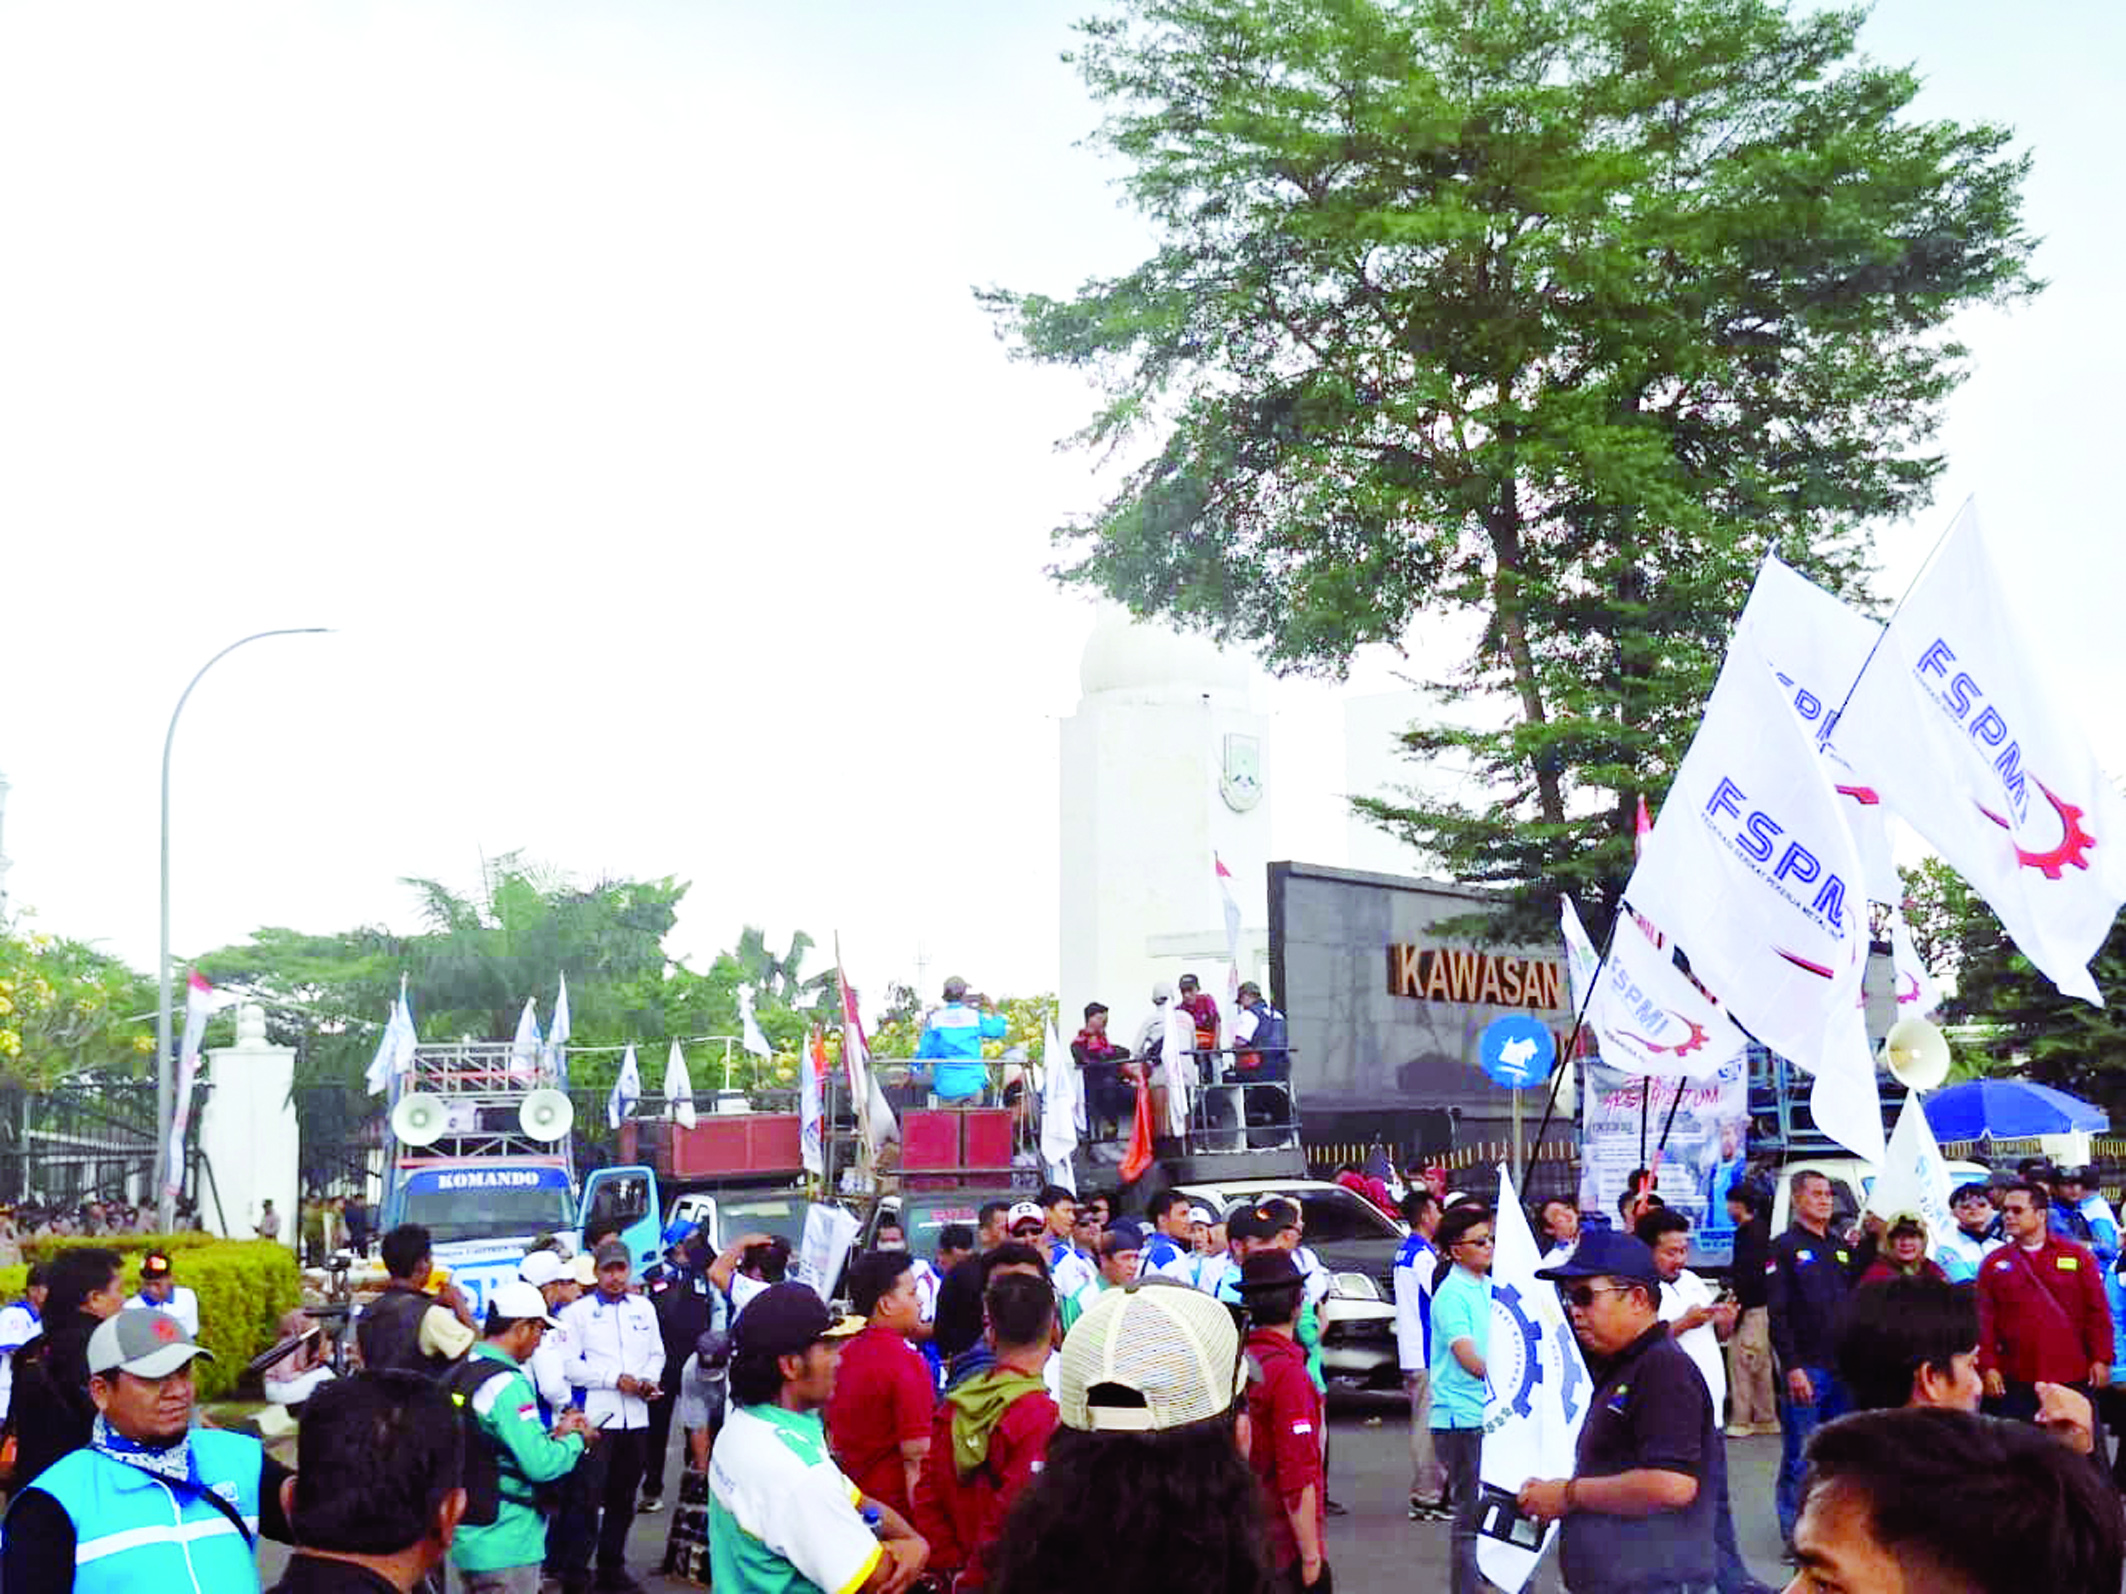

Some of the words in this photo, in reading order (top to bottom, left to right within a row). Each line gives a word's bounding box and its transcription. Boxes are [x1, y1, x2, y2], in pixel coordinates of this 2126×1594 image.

[1705, 776, 1845, 928] FSPM
[1396, 943, 1564, 1010] KAWASAN
[437, 1171, 541, 1190] KOMANDO
